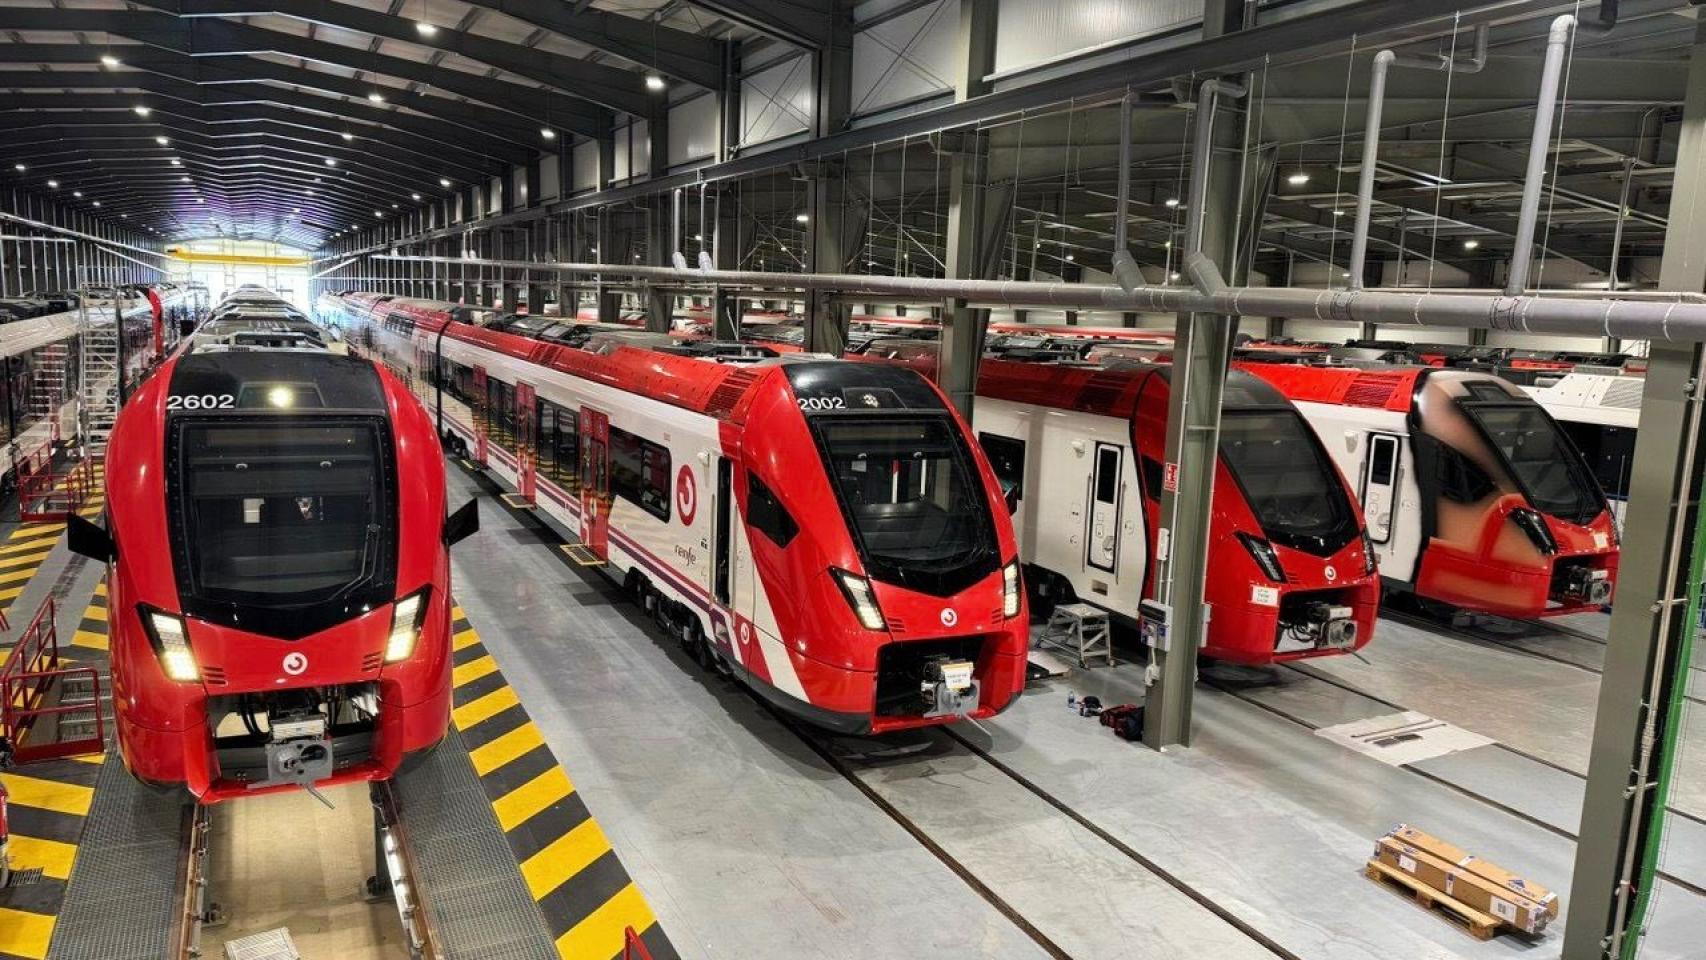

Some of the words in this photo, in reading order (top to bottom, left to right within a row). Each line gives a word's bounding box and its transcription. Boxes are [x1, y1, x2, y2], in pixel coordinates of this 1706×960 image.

[167, 394, 235, 409] 2602
[797, 396, 846, 410] 2002
[674, 545, 697, 566] renfe
